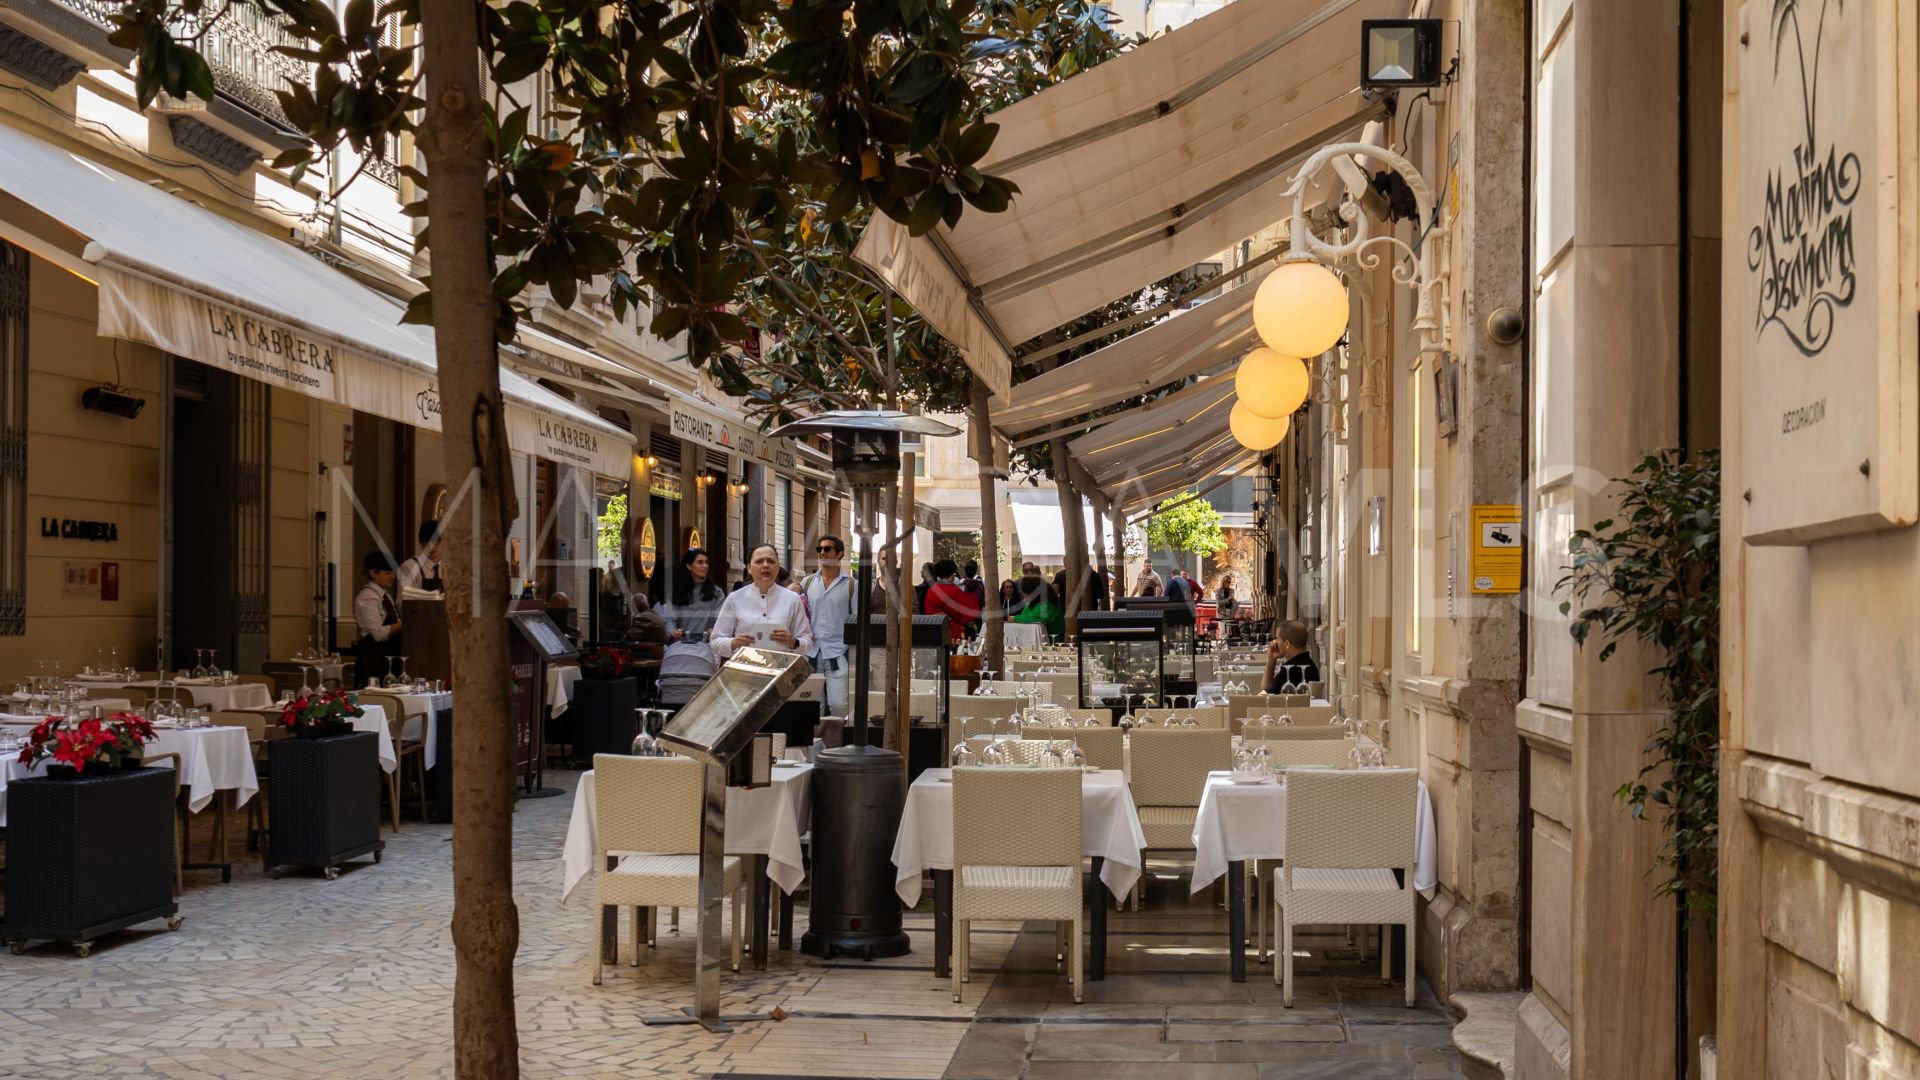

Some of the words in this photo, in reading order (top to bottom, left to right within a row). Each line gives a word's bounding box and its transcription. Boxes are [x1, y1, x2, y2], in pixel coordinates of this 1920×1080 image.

[208, 307, 238, 341] LA
[243, 320, 336, 375] CABRERA
[227, 348, 238, 364] by
[538, 418, 552, 440] LA
[553, 422, 599, 454] CABRERA
[673, 410, 713, 443] RISTORANTE
[738, 435, 755, 456] GUSTO
[41, 517, 59, 538] LA
